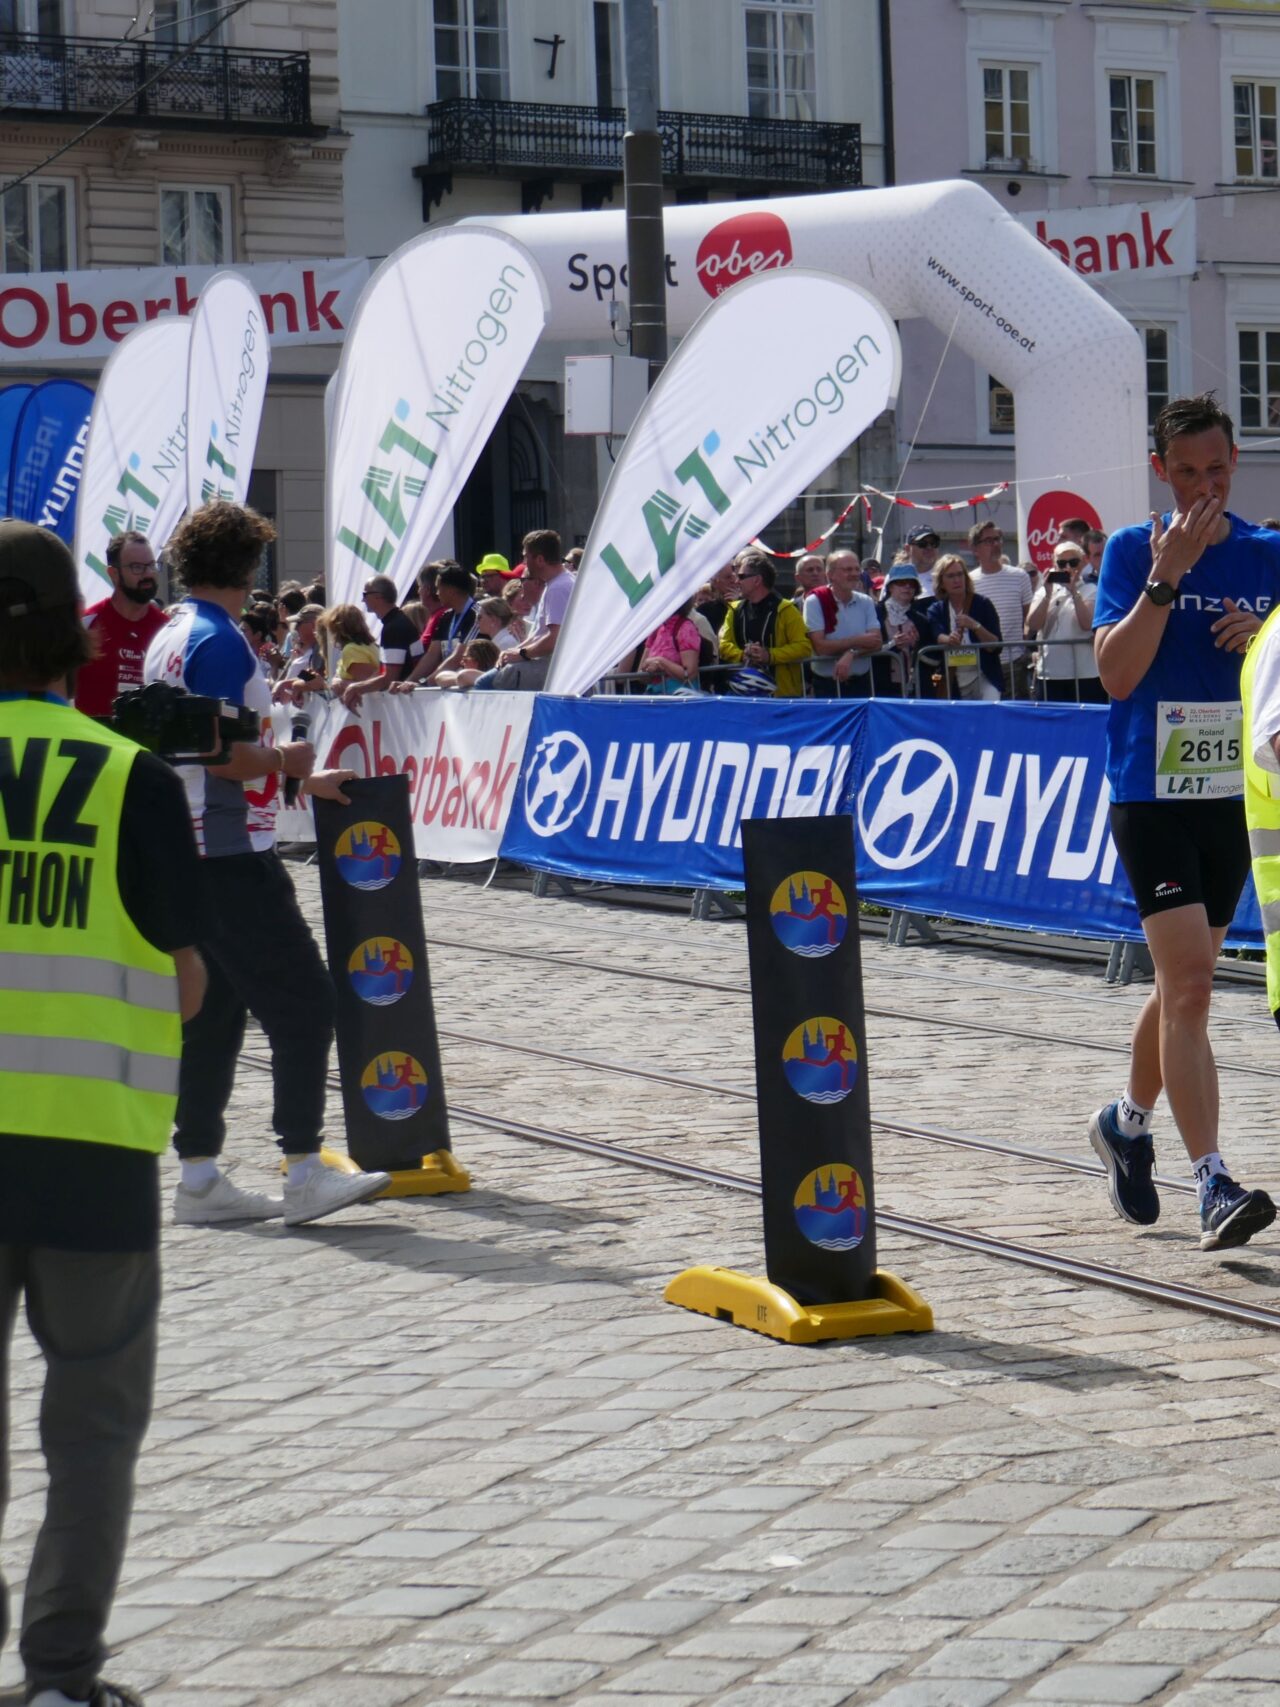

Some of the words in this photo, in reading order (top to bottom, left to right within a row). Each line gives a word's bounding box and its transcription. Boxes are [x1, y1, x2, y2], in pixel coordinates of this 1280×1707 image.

[0, 271, 345, 349] Obernk
[568, 253, 679, 301] Spt
[927, 256, 1036, 353] www.sport-ooe.at
[224, 309, 259, 449] Nitrogen
[426, 262, 525, 432] Nitrogen
[734, 334, 881, 484] Nitrogen
[337, 418, 438, 572] LAT
[600, 442, 732, 607] LAT
[1236, 596, 1271, 613] AG
[1168, 776, 1206, 795] LAT
[1180, 739, 1240, 762] 2615
[1155, 886, 1183, 898] skinfit
